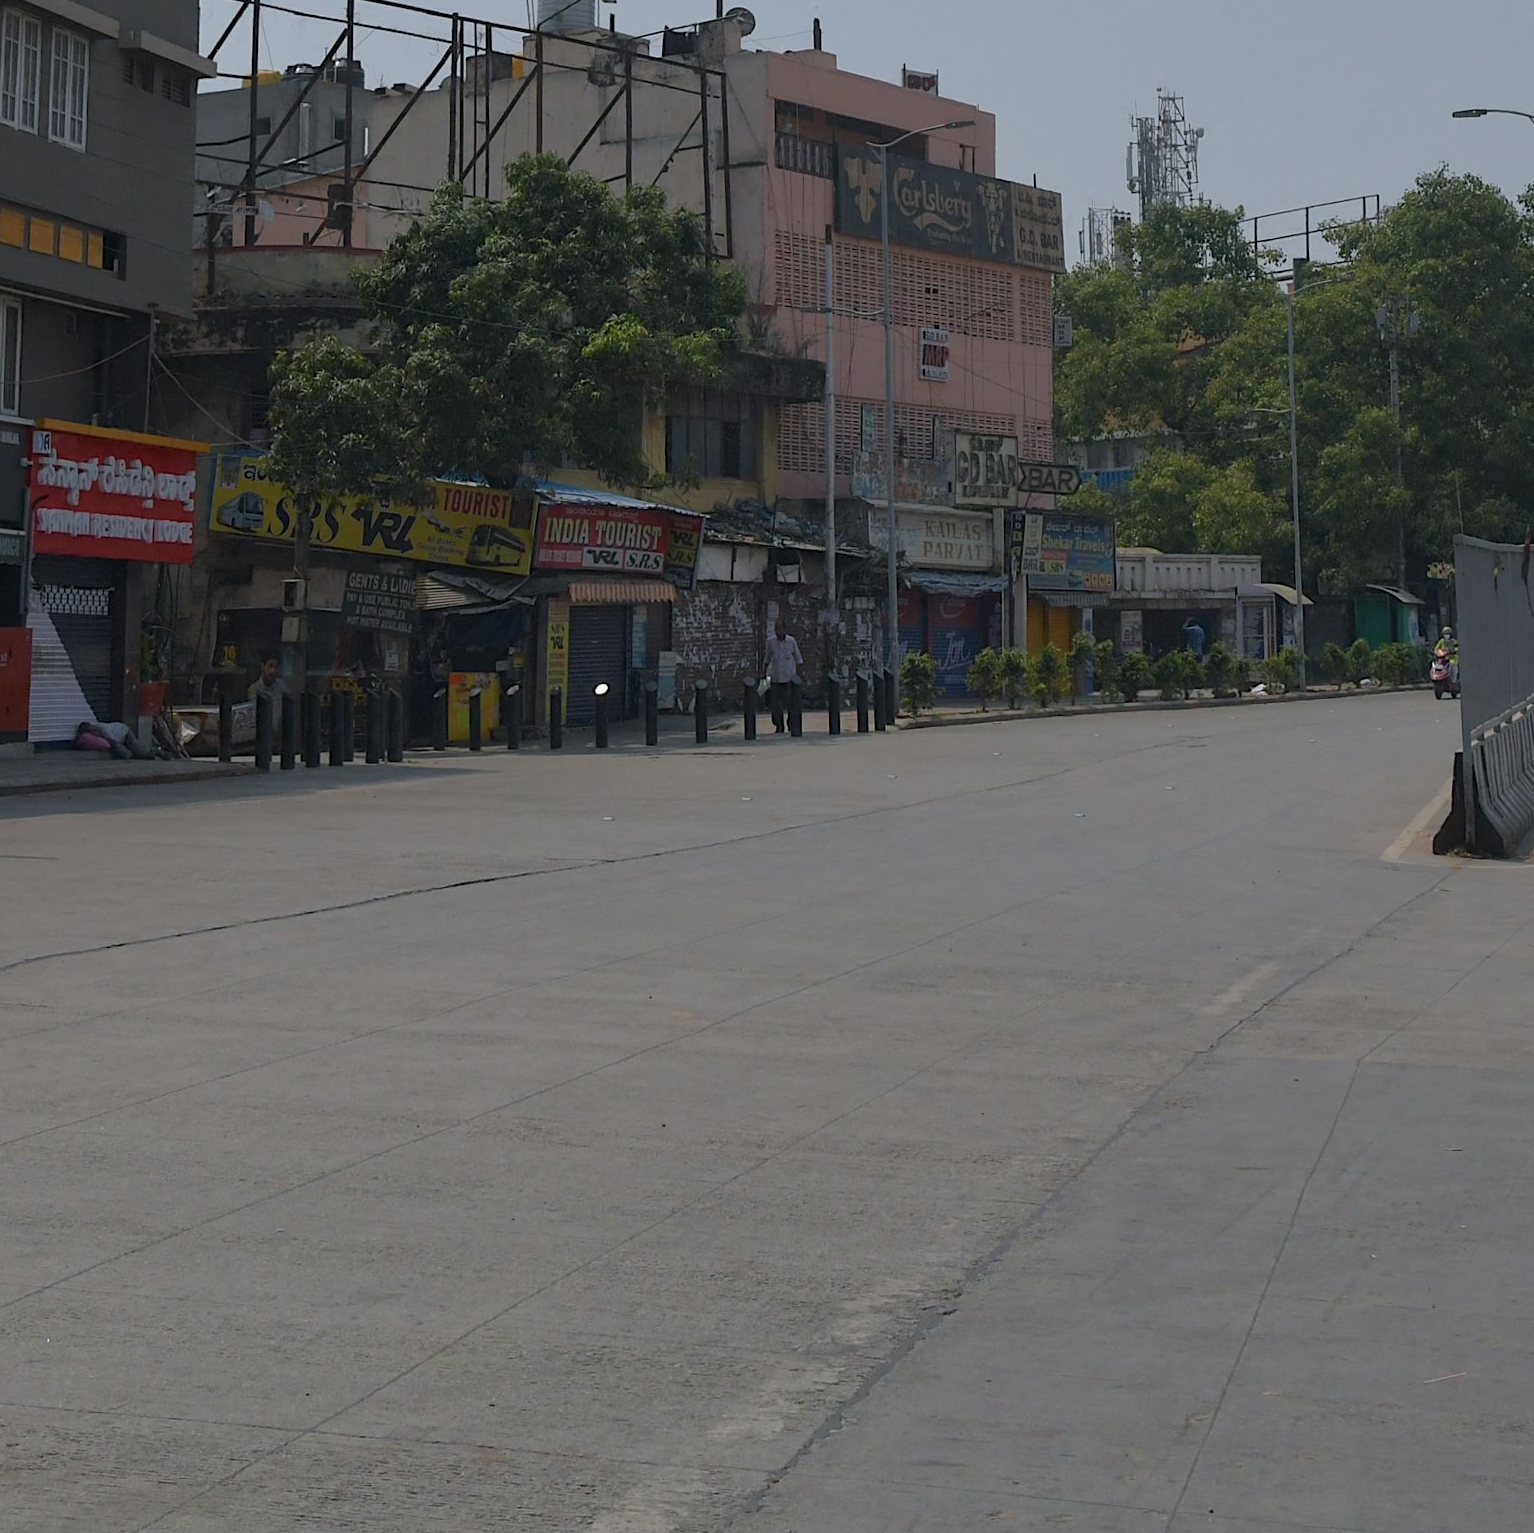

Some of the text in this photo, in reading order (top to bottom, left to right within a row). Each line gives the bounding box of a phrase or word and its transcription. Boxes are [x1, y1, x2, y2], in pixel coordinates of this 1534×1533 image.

[893, 167, 972, 228] Carlsberg
[1041, 233, 1059, 250] BAR
[923, 344, 949, 367] MRP
[985, 453, 1016, 486] BAR
[1029, 469, 1073, 490] BAR
[443, 488, 510, 519] TOURIST
[37, 508, 194, 544] SANMAN RESIDENCY LODGE
[352, 507, 416, 554] VRL
[544, 517, 662, 552] INDIA TOURIST
[925, 520, 981, 540] KAILAS
[1042, 534, 1105, 553] Shekar Travels
[586, 549, 620, 565] VRL
[626, 552, 662, 570] S.R.S
[349, 572, 379, 590] GENTS
[381, 576, 387, 591] &
[347, 592, 357, 602] PAY
[364, 595, 376, 605] USE
[377, 595, 398, 607] PUBLIC
[378, 608, 405, 620] COMPLEX
[382, 619, 413, 633] AVAILABLE
